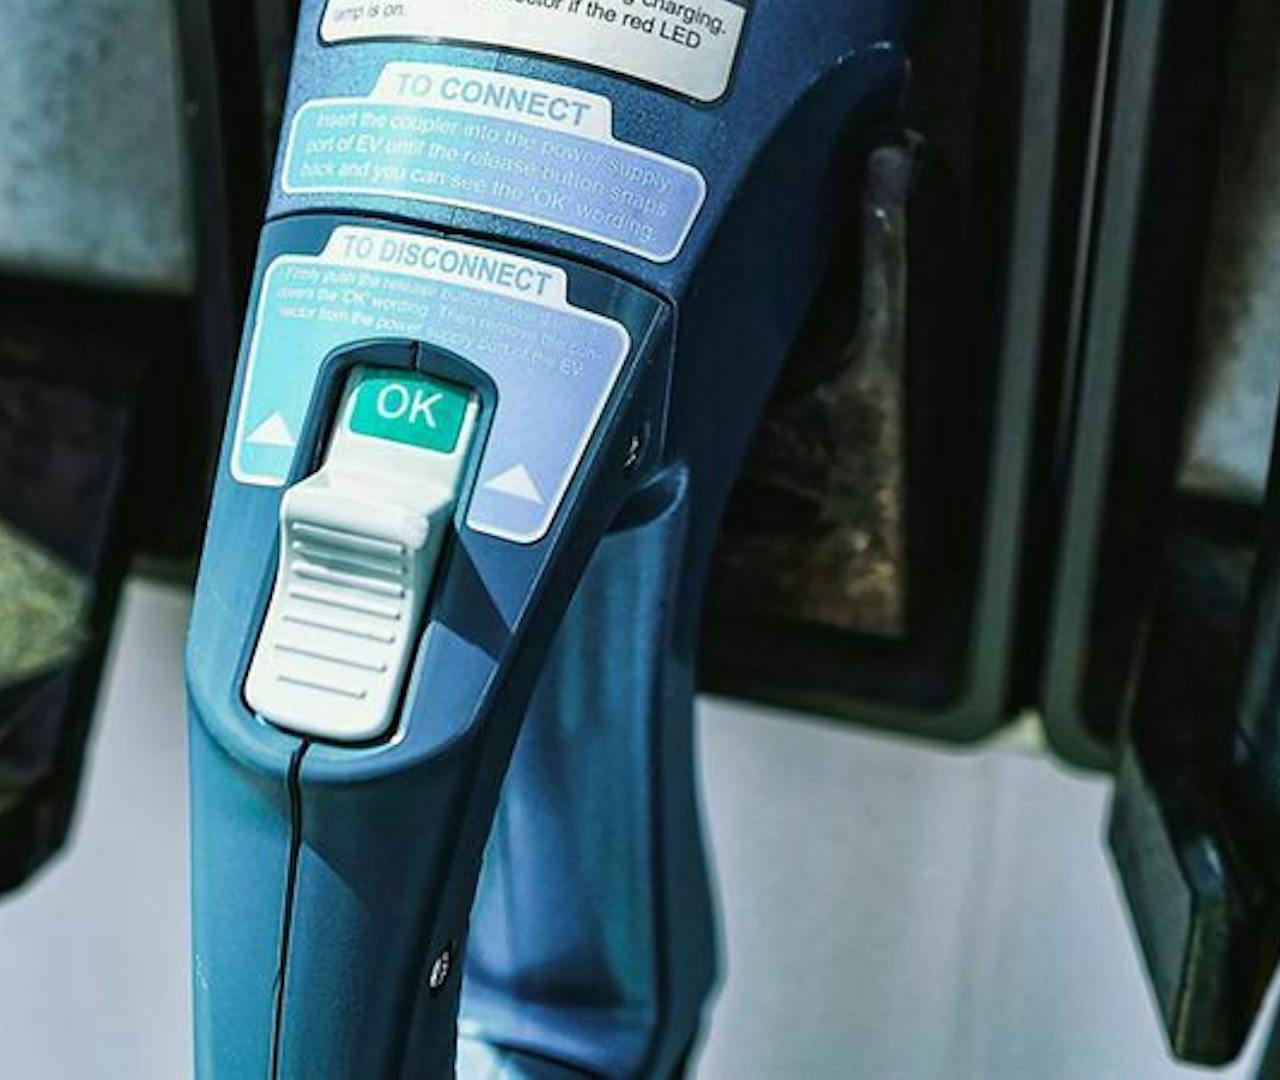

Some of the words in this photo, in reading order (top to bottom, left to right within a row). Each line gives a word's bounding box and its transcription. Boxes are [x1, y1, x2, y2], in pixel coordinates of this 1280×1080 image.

[585, 1, 617, 23] the
[622, 12, 654, 34] red
[660, 20, 702, 50] LED
[394, 72, 433, 97] TO
[440, 77, 592, 127] CONNECT
[356, 133, 382, 153] EV
[428, 140, 459, 162] the
[462, 147, 539, 178] release
[390, 114, 461, 136] coupler
[464, 122, 499, 141] into
[542, 140, 605, 168] power
[370, 164, 406, 183] you
[409, 168, 445, 186] can
[449, 175, 489, 194] see
[491, 178, 524, 201] the
[341, 234, 376, 260] TO
[379, 238, 552, 297] DISCONNECT
[376, 382, 446, 430] OK
